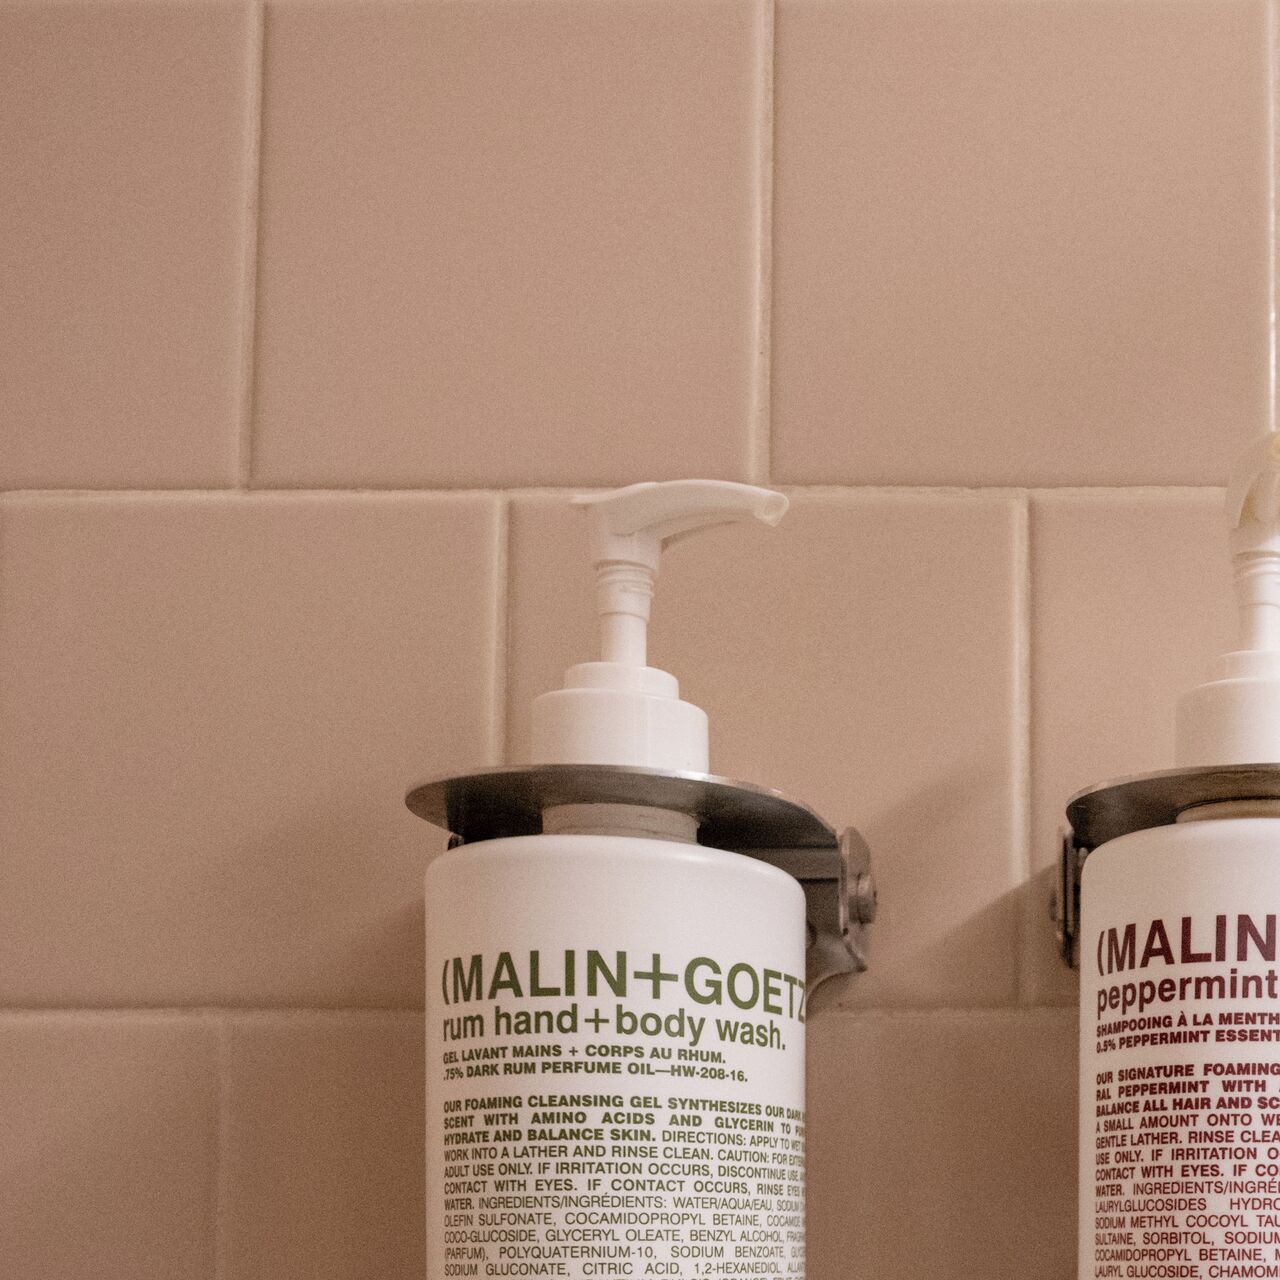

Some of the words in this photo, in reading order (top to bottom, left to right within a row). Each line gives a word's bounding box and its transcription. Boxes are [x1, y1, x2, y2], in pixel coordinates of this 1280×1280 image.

[1097, 968, 1279, 1020] peppermint
[443, 1014, 484, 1042] rum
[715, 1019, 786, 1050] wash.
[1096, 1015, 1173, 1038] SHAMPOOING
[1177, 1011, 1188, 1027] À
[1193, 1013, 1214, 1026] LA
[1096, 1038, 1116, 1054] 0.5%
[1119, 1030, 1210, 1049] PEPPERMINT
[443, 1051, 459, 1065] GEL
[462, 1046, 508, 1062] LAVANT
[512, 1044, 562, 1058] MAINS
[585, 1044, 644, 1058] CORPS
[649, 1047, 672, 1060] AU
[678, 1048, 726, 1064] RHUM.
[466, 1063, 500, 1078] DARK
[503, 1062, 536, 1075] RUM
[541, 1061, 622, 1074] PERFUME
[1096, 1071, 1113, 1086] OUR
[1118, 1064, 1195, 1082] SIGNATURE
[1118, 1080, 1210, 1098] PEPPERMINT
[1221, 1080, 1266, 1092] WITH
[443, 1100, 462, 1114] OUR
[465, 1095, 523, 1111] FOAMING
[527, 1095, 624, 1108] CLEANSING
[630, 1096, 662, 1109] GEL
[668, 1097, 762, 1116] SYNTHESIZES
[765, 1105, 785, 1118] OUR
[1096, 1100, 1140, 1118] BALANCE
[1143, 1099, 1168, 1112] ALL
[1172, 1097, 1211, 1111] HAIR
[1216, 1097, 1252, 1109] AND
[444, 1130, 490, 1146] HYDRATE
[493, 1129, 522, 1142] AND
[527, 1128, 604, 1141] BALANCE
[610, 1128, 656, 1142] SKIN.
[662, 1130, 746, 1146] DIRECTIONS:
[749, 1135, 778, 1148] APPLY
[1130, 1131, 1182, 1146] LATHER.
[1188, 1130, 1234, 1144] RINSE
[498, 1162, 533, 1176] ONLY.
[538, 1162, 551, 1175] IF
[556, 1162, 642, 1175] IRRITATION
[648, 1163, 713, 1179] OCCURS,
[718, 1165, 786, 1180] DISCONTINUE
[478, 1212, 556, 1226] SULFONATE,
[565, 1212, 706, 1225] COCAMIDOPROPYL
[713, 1213, 762, 1227] BETAINE,
[1130, 1215, 1179, 1228] METHYL
[1185, 1214, 1249, 1228] COCOYL
[1143, 1231, 1214, 1246] SORBITOL,
[499, 1245, 657, 1259] POLYQUATERNIUM-10,
[671, 1245, 724, 1258] SODIUM
[582, 1262, 633, 1276] CITRIC
[644, 1262, 683, 1276] ACID,
